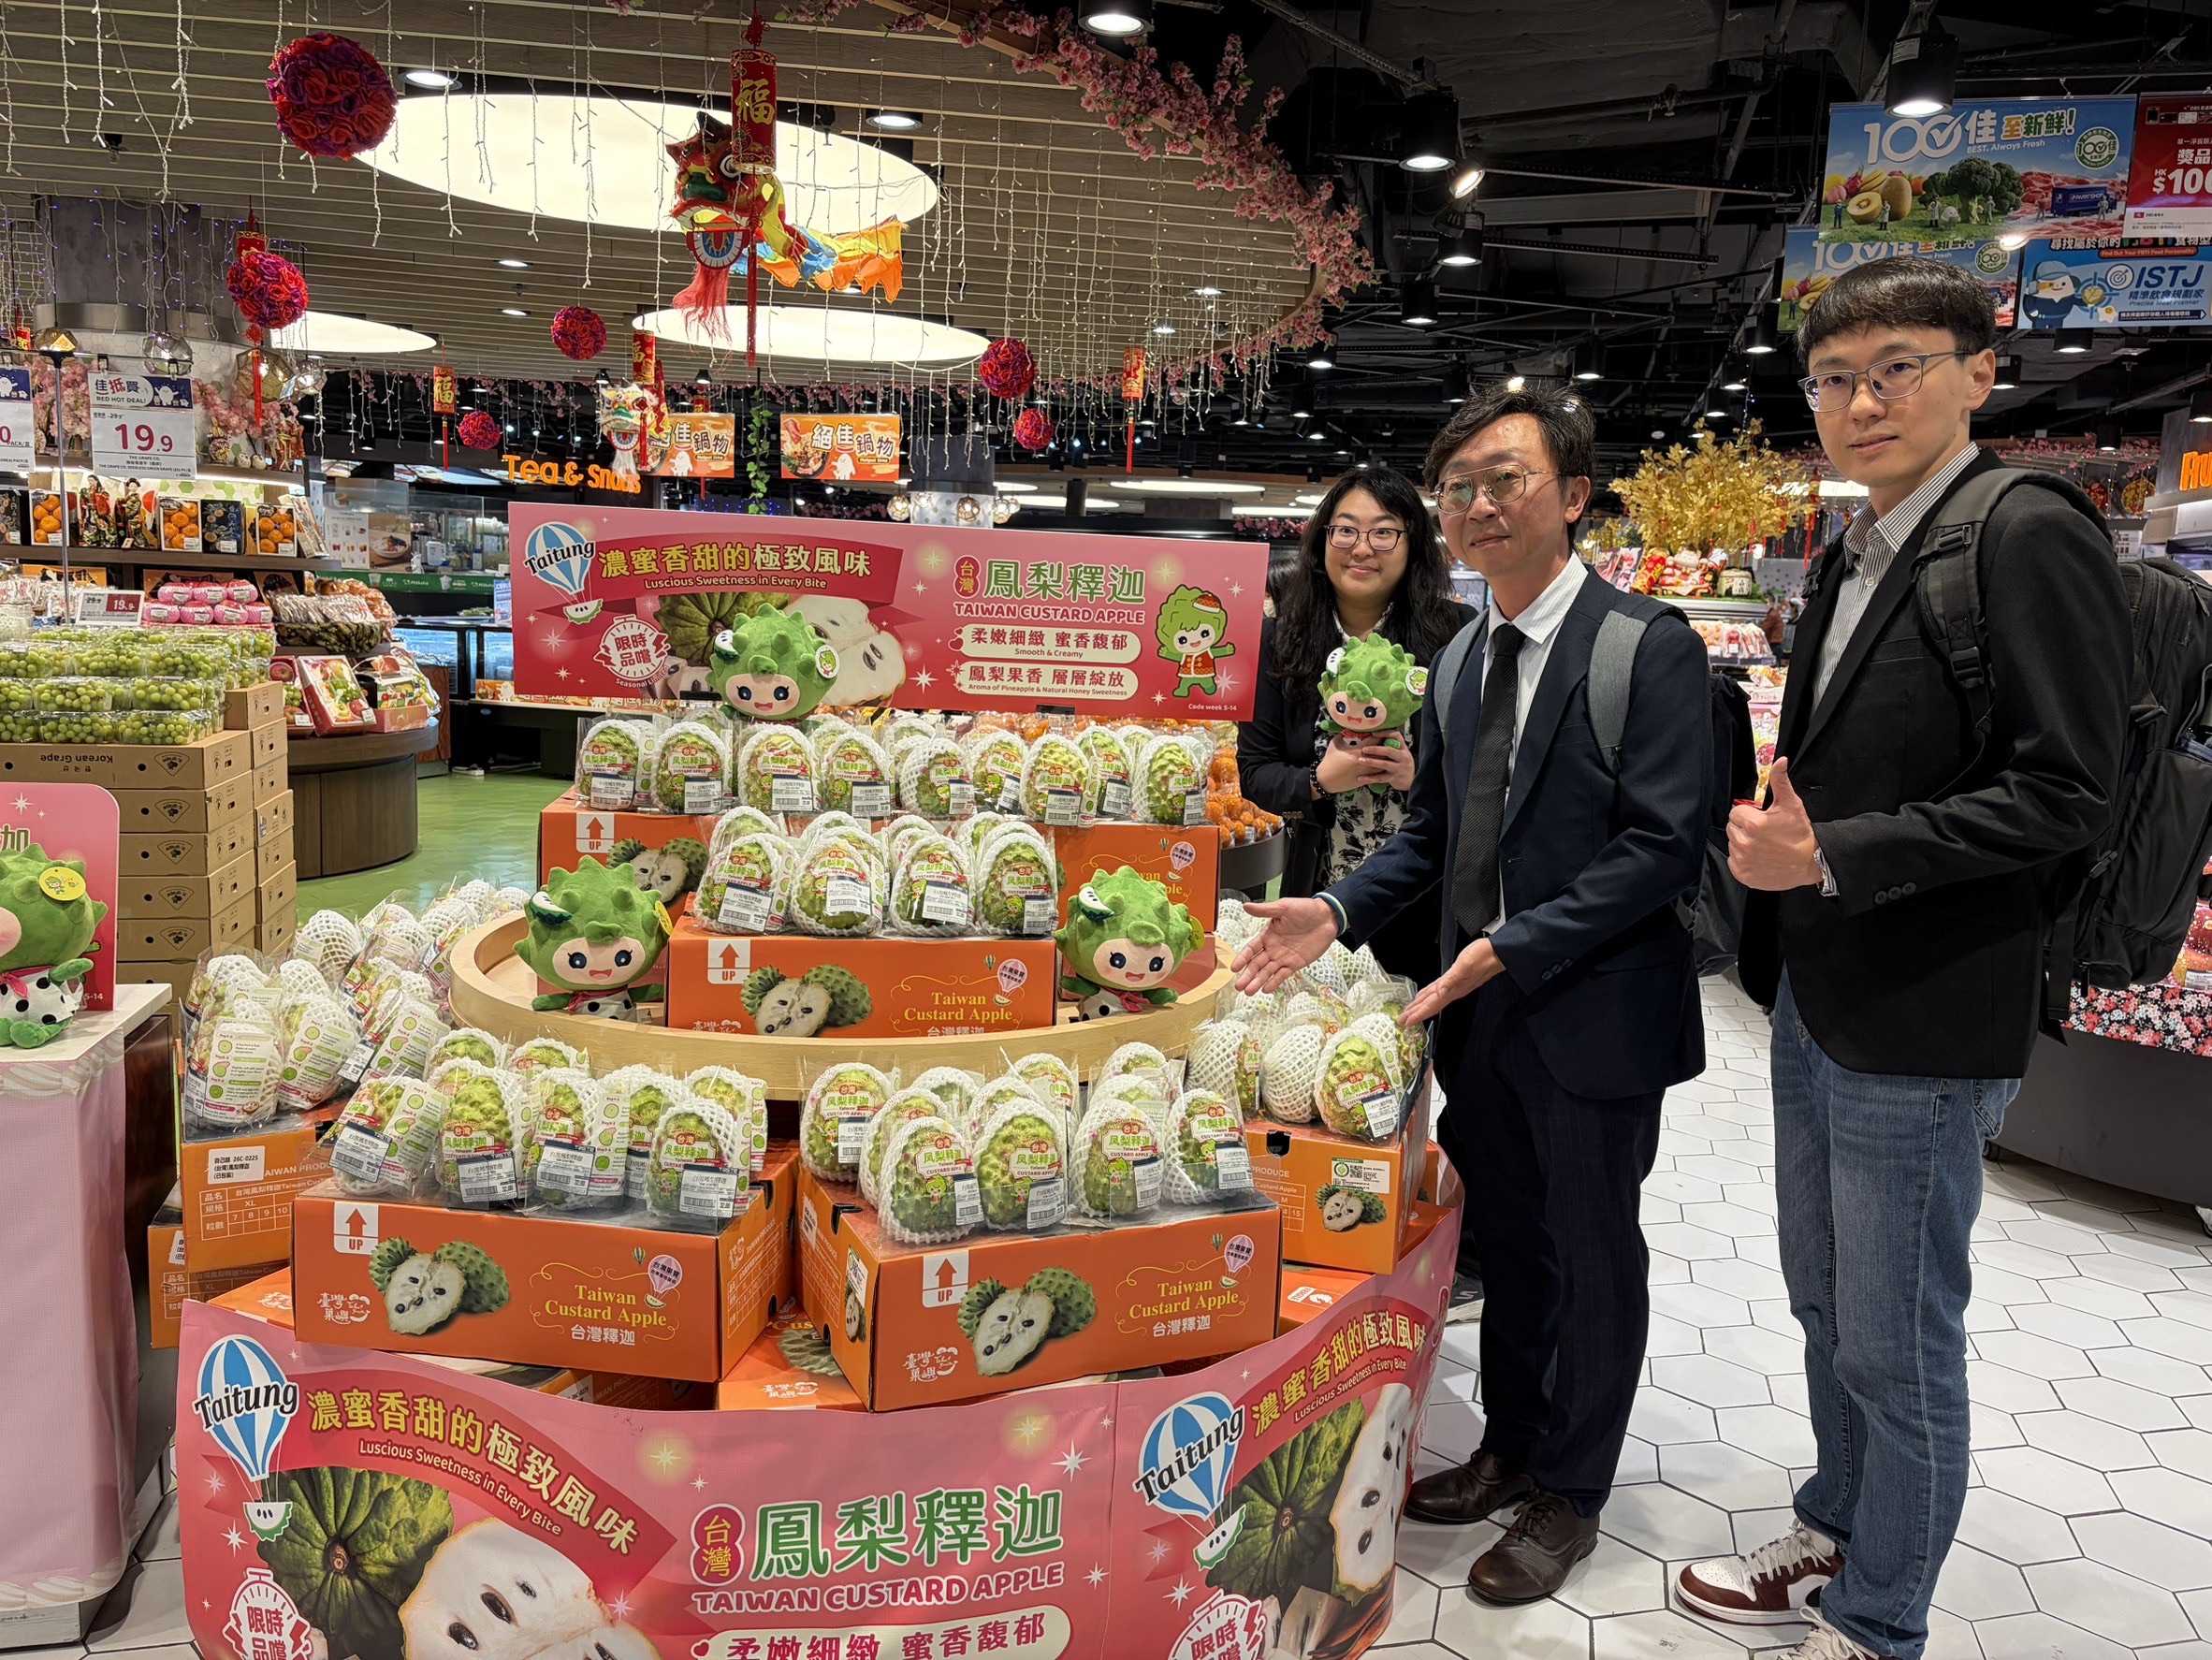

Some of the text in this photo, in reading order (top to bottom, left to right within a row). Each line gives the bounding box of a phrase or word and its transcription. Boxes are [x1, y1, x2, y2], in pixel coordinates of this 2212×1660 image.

[735, 79, 776, 124] 福
[1967, 139, 2045, 154] BEST. Always Fresh
[2134, 264, 2205, 288] ISTJ
[95, 377, 140, 395] 佳抵買
[434, 375, 455, 404] 福
[115, 423, 174, 453] 19.9
[502, 454, 560, 486] Tea
[563, 461, 584, 486] &
[523, 539, 595, 577] Taitung
[601, 543, 872, 578] 濃蜜香甜的極致風味
[644, 575, 827, 590] Luscious Sweetness in Every Bite
[958, 560, 976, 594] 台灣
[985, 560, 1146, 604] 鳳梨釋迦
[954, 603, 1145, 625] TAIWAN CUSTARD APPLE
[615, 633, 648, 650] 限時
[971, 628, 1128, 650] 柔嫩細緻 蜜香馥郁
[1014, 648, 1044, 657] Smooth
[1055, 648, 1084, 660] Creamy
[615, 677, 648, 690] Seasonal
[968, 665, 1125, 688] 鳳梨果香 層層綻放
[968, 682, 991, 691] Aroma
[1001, 684, 1033, 695] Pineapple
[1042, 686, 1067, 694] Natural
[1069, 688, 1090, 697] Honey
[1091, 688, 1128, 696] Sweetness
[1187, 702, 1204, 710] Code
[1205, 703, 1221, 711] week
[40, 754, 113, 764] Korean Grape
[589, 840, 602, 852] UP
[721, 969, 736, 983] UP
[931, 992, 987, 1006] Taiwan
[903, 1007, 1013, 1025] Custard Apple
[232, 1155, 258, 1163] 26C-0225
[264, 1166, 298, 1178] AIWAN
[204, 1192, 224, 1201] 品名
[1255, 1182, 1298, 1194] Custard Apple
[205, 1203, 224, 1214] 規格
[244, 1200, 256, 1208] XL
[276, 1206, 288, 1215] 10
[1292, 1209, 1301, 1217] 15
[347, 1237, 364, 1252] UP
[575, 1285, 636, 1305] Taiwan
[937, 1289, 954, 1303] UP
[1157, 1279, 1214, 1298] Taiwan
[545, 1300, 667, 1329] Custard Apple
[1128, 1290, 1240, 1320] Custard Apple
[570, 1324, 635, 1347] 台灣釋迦
[1152, 1316, 1211, 1338] 台灣釋迦
[1251, 1310, 1427, 1438] 濃蜜香甜的極致風味
[1293, 1358, 1407, 1423] Luscious Sweetness in Every Bite
[194, 1380, 299, 1431] Taitung
[1134, 1405, 1245, 1505] Taitung
[308, 1388, 639, 1556] 濃蜜香甜的極致風味
[359, 1440, 563, 1536] Luscious Sweetness in Every Bite
[750, 1486, 1064, 1580] 鳳梨釋迦
[702, 1514, 732, 1579] 台灣
[692, 1563, 1065, 1613] TAIWAN CUSTARD APPLE
[246, 1606, 284, 1638] 限時
[727, 1612, 1046, 1660] 柔嫩細緻 蜜香馥郁
